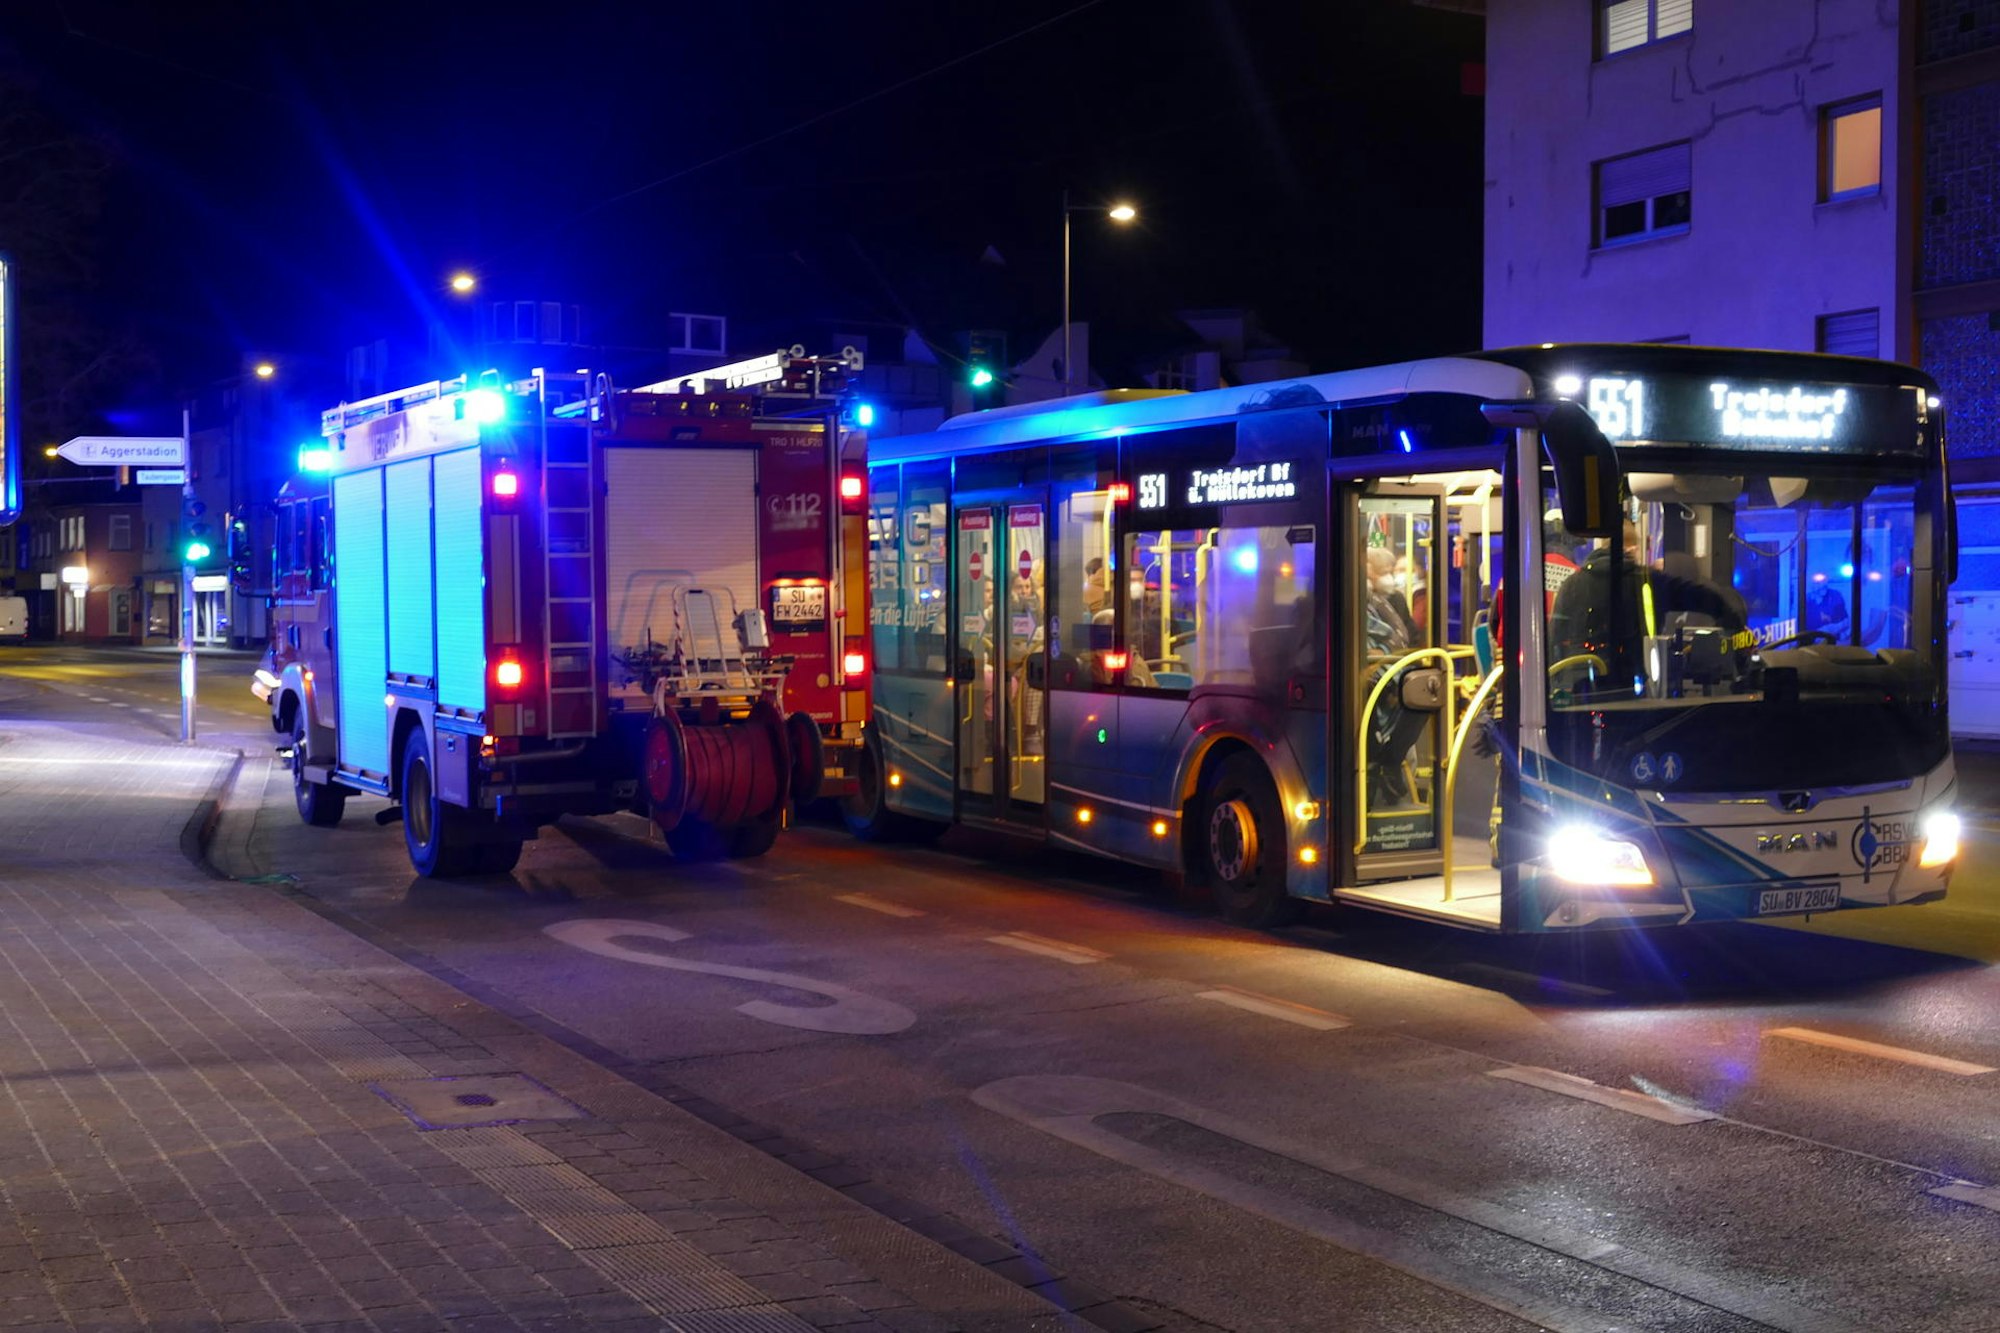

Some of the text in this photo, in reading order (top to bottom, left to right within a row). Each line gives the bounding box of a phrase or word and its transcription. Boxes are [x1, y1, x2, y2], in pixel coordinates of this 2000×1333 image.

[1589, 378, 1847, 437] 551 Troisdorf
[1352, 424, 1389, 438] MAN
[101, 446, 178, 458] Aggerstadion
[1139, 463, 1290, 508] 551 Troisdorf Bf
[786, 493, 822, 515] 112
[791, 589, 806, 603] SU
[776, 604, 822, 617] FW 2442
[1757, 830, 1838, 853] MAN
[1760, 888, 1836, 912] SU BV 2804
